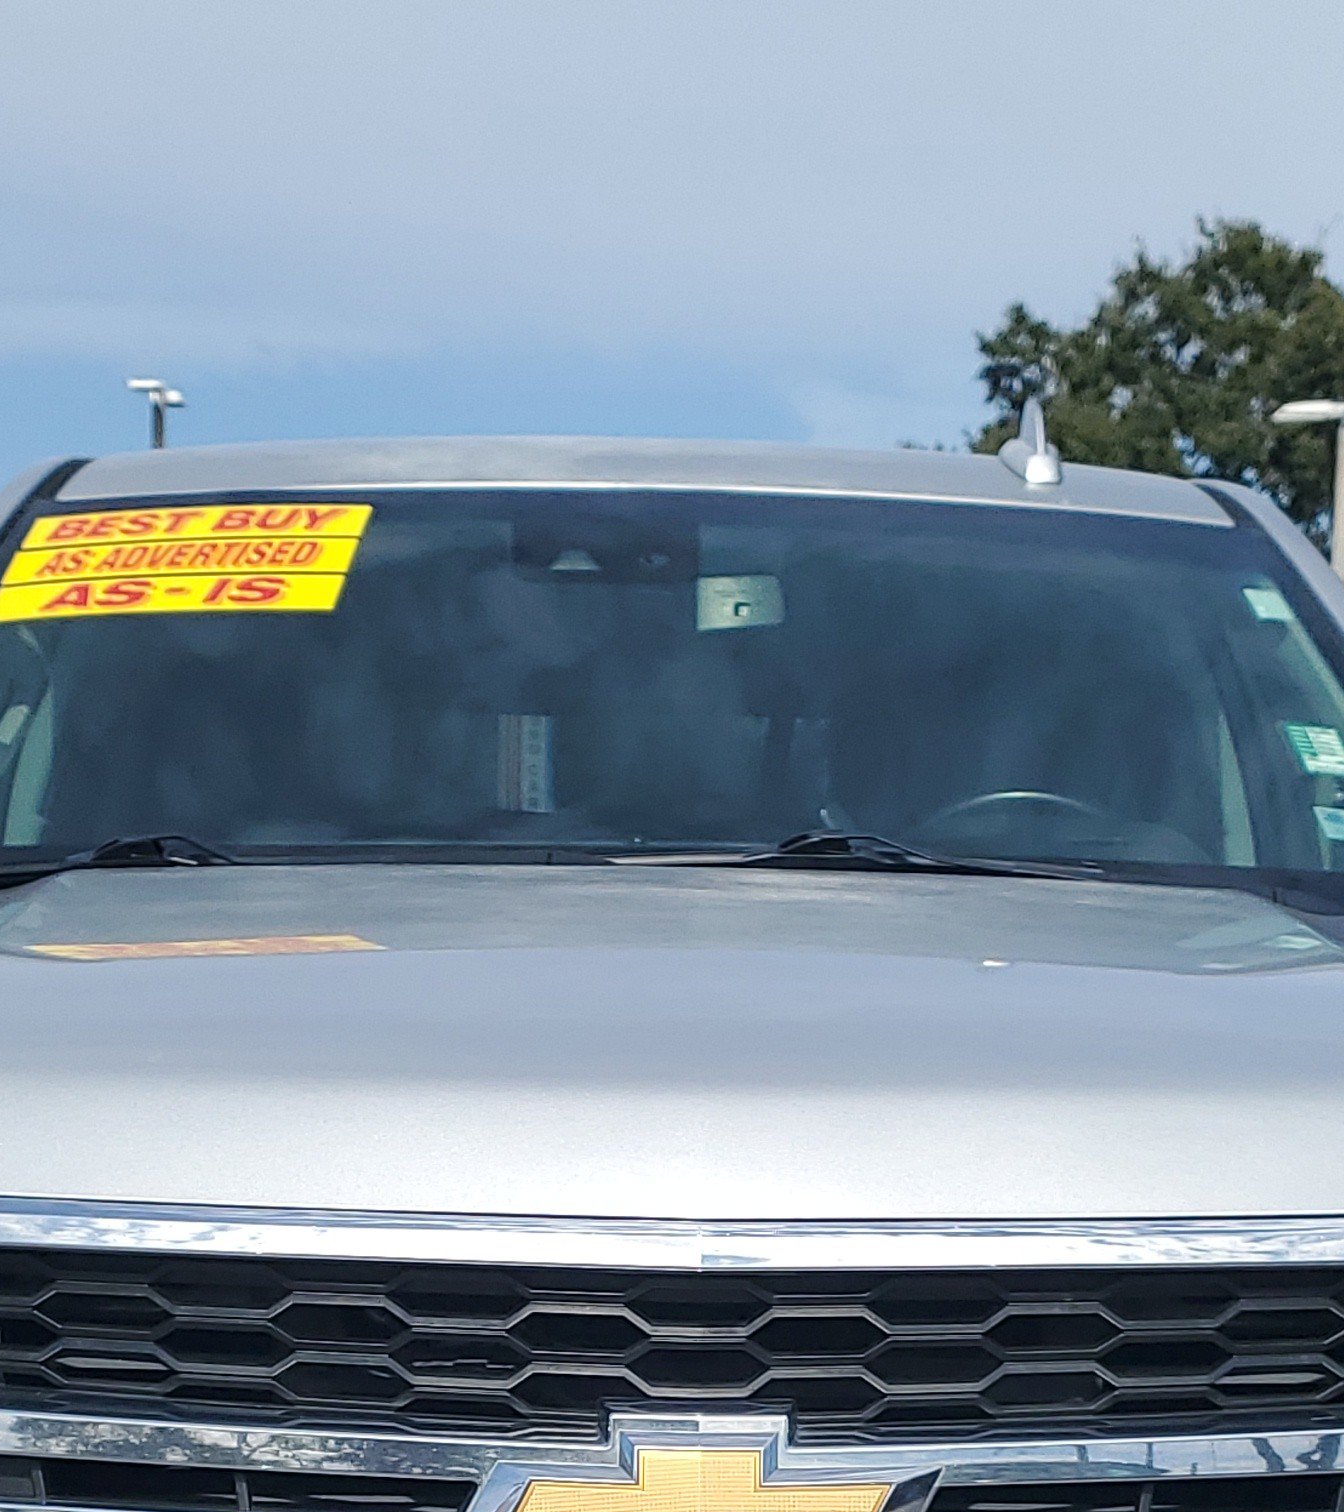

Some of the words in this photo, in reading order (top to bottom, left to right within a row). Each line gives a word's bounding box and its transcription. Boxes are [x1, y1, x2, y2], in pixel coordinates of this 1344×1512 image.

[45, 511, 206, 542] BEST
[210, 508, 348, 533] BUY
[34, 548, 94, 577] AS
[94, 540, 323, 573] ADVERTISED
